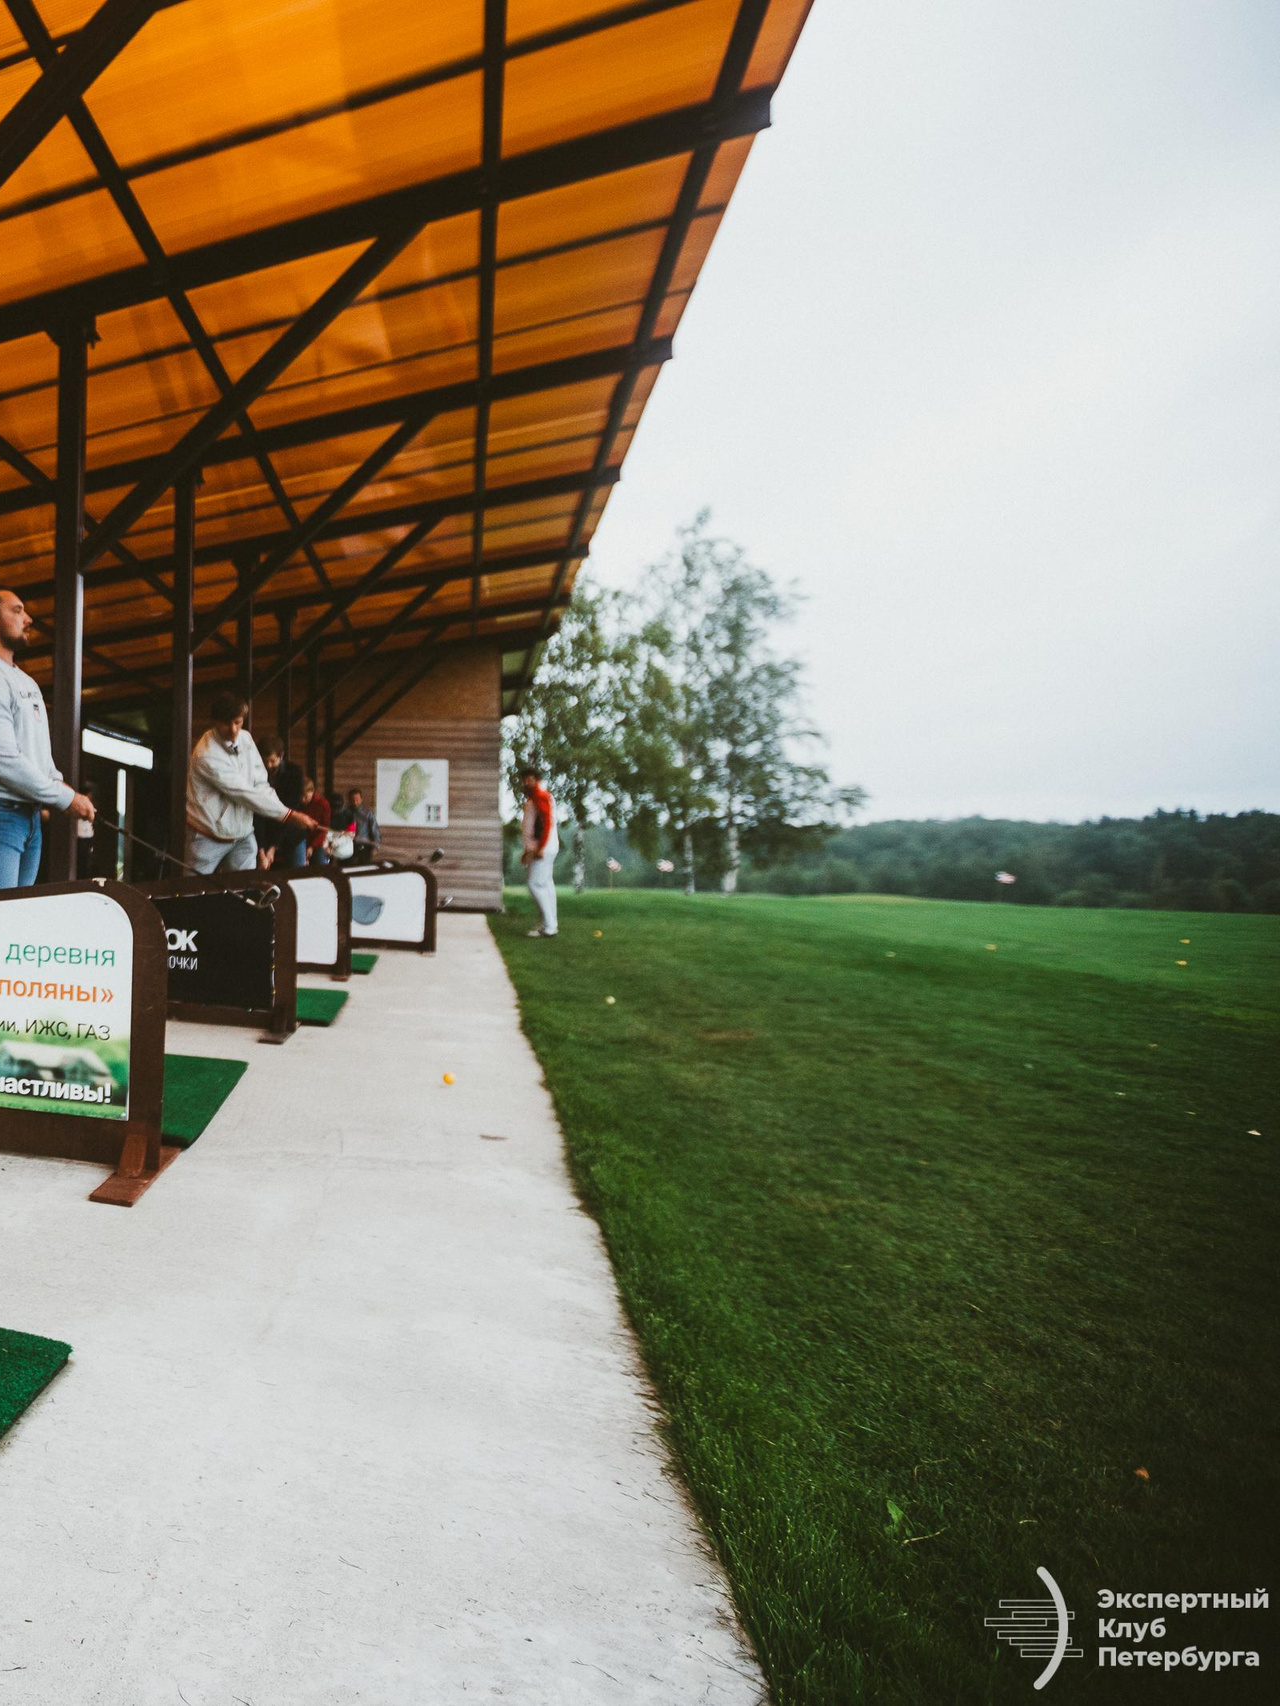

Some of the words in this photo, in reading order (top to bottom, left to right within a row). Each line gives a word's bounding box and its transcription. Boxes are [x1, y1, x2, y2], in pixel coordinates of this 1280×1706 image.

[5, 942, 116, 968] деревня
[25, 1018, 72, 1040] ИЖС,
[77, 1022, 111, 1042] ГАЗ
